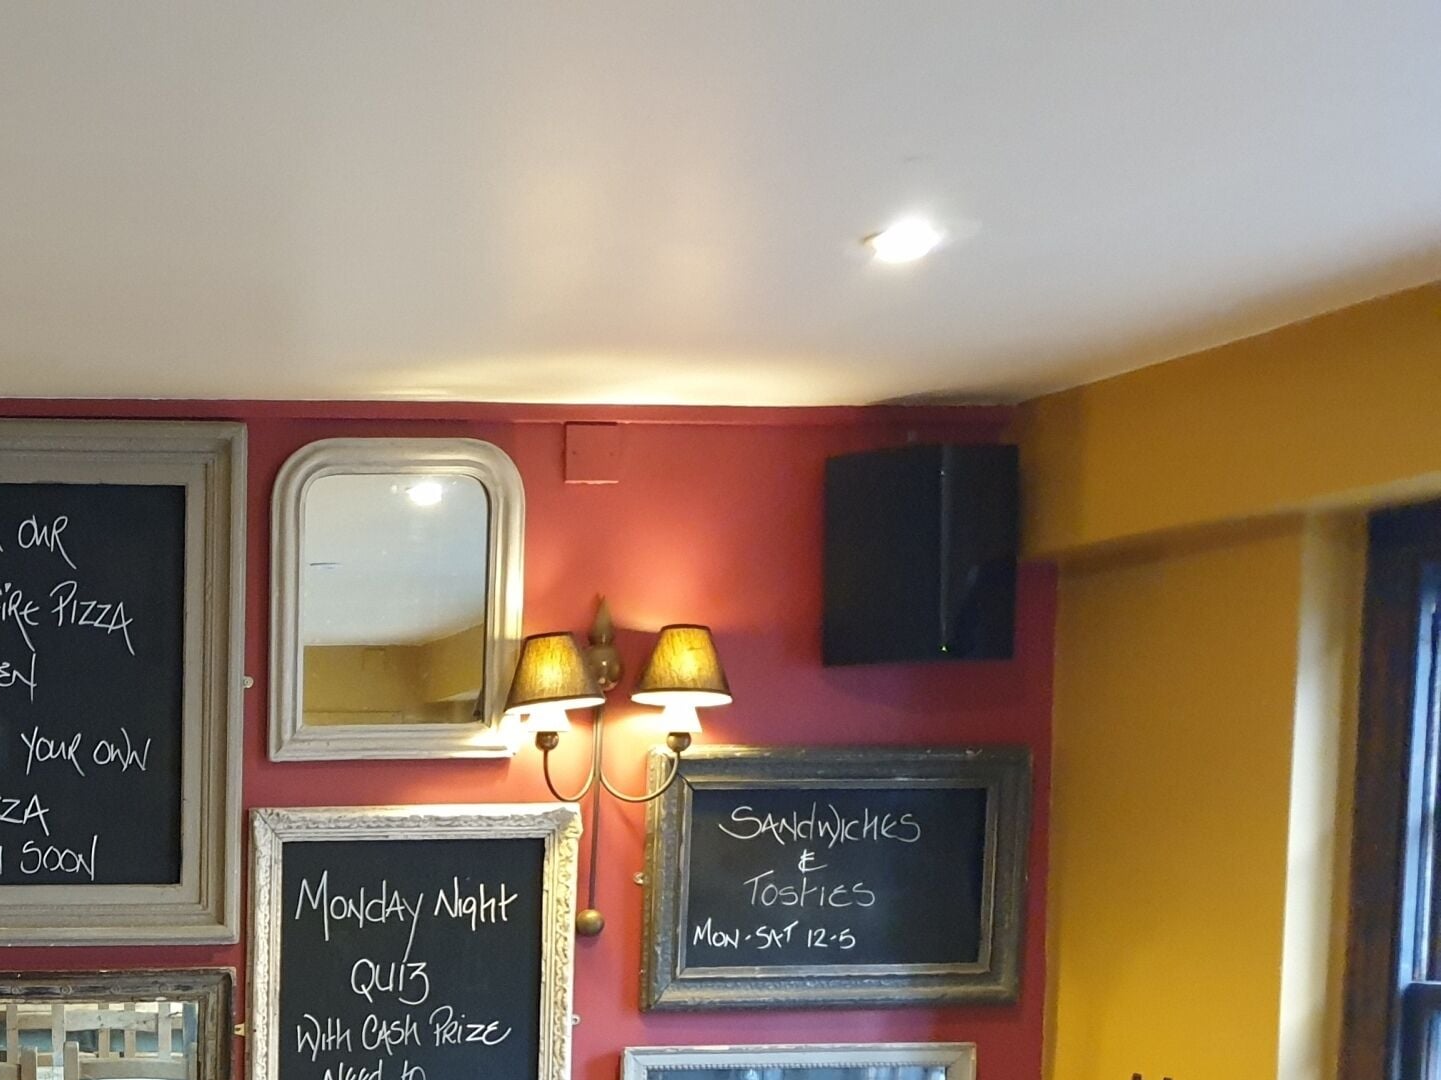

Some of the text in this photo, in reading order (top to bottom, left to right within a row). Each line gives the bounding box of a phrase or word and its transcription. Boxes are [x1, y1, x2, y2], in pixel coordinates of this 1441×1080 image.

[50, 580, 135, 656] PIZZA
[21, 726, 85, 777] YOUR
[93, 728, 151, 772] OWN
[20, 834, 98, 881] SOON
